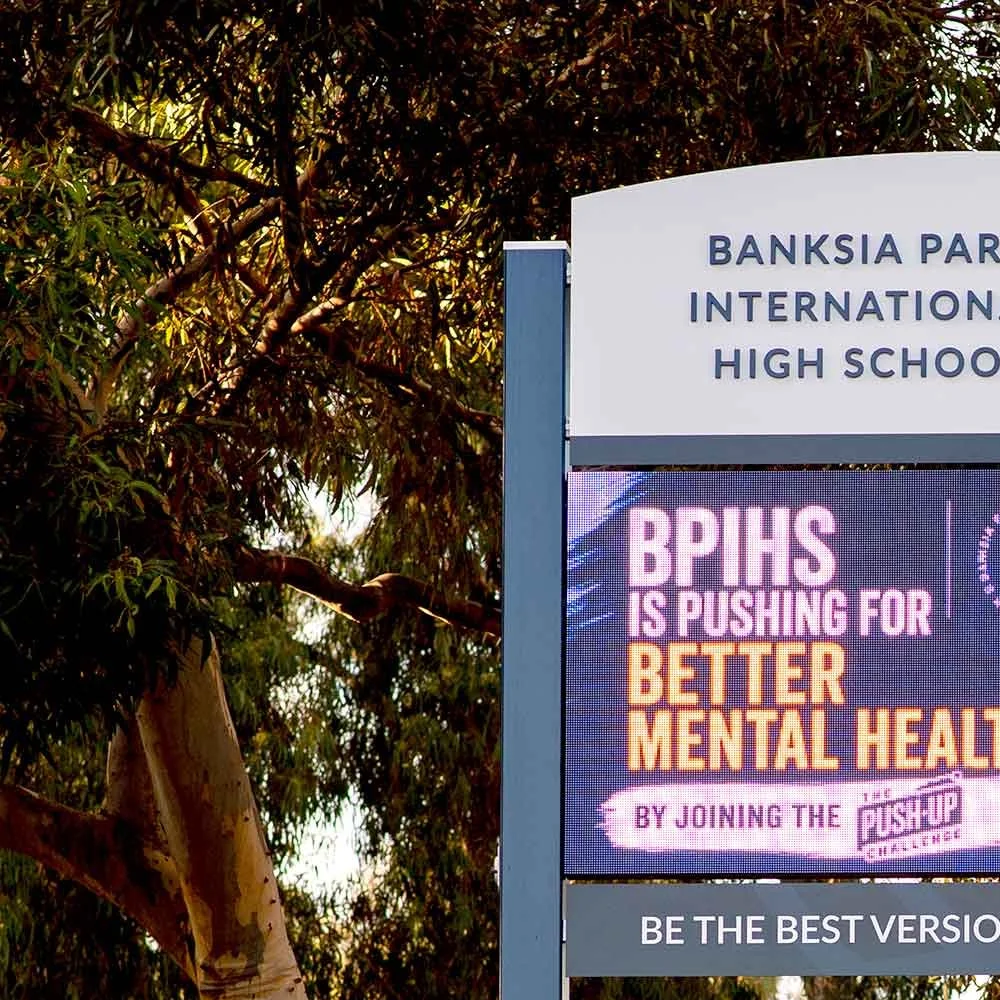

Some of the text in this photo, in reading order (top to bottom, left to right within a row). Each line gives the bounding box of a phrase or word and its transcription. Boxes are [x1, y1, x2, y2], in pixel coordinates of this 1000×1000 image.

[710, 234, 903, 265] BANKSIA
[714, 347, 824, 380] HIGH
[628, 505, 837, 587] BPIHS
[628, 589, 933, 638] IS PUSHING FOR
[628, 641, 847, 706] BETTER
[628, 707, 840, 771] MENTAL
[864, 788, 892, 802] THE
[635, 804, 841, 829] BY JOINING THE
[860, 791, 958, 841] PUSH-UP
[867, 828, 961, 859] CHALLENGE
[641, 915, 685, 945] BE
[688, 915, 766, 945] THE
[776, 914, 864, 944] BEST
